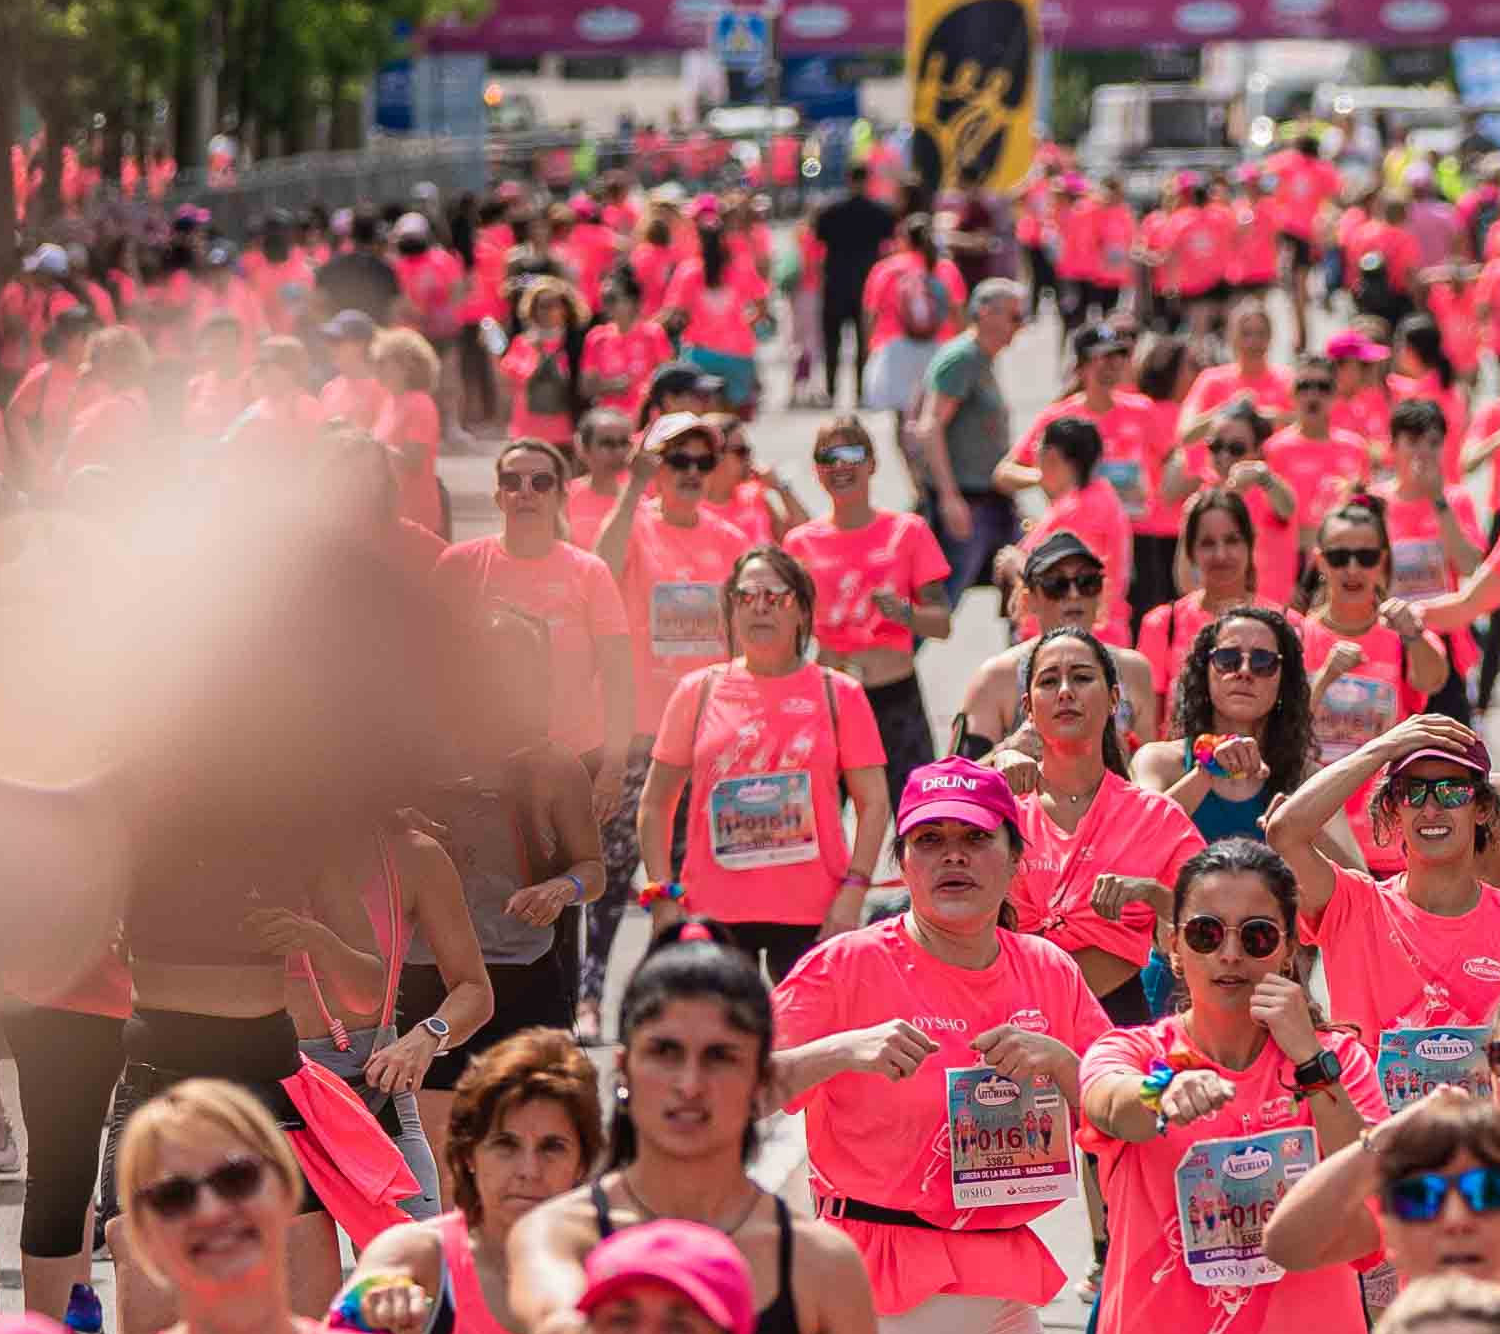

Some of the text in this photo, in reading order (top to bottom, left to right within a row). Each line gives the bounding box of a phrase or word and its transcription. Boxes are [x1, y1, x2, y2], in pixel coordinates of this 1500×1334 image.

[912, 1015, 968, 1032] OYSHO
[1419, 1043, 1470, 1055] ASTURIANA
[978, 1127, 1023, 1151] 016
